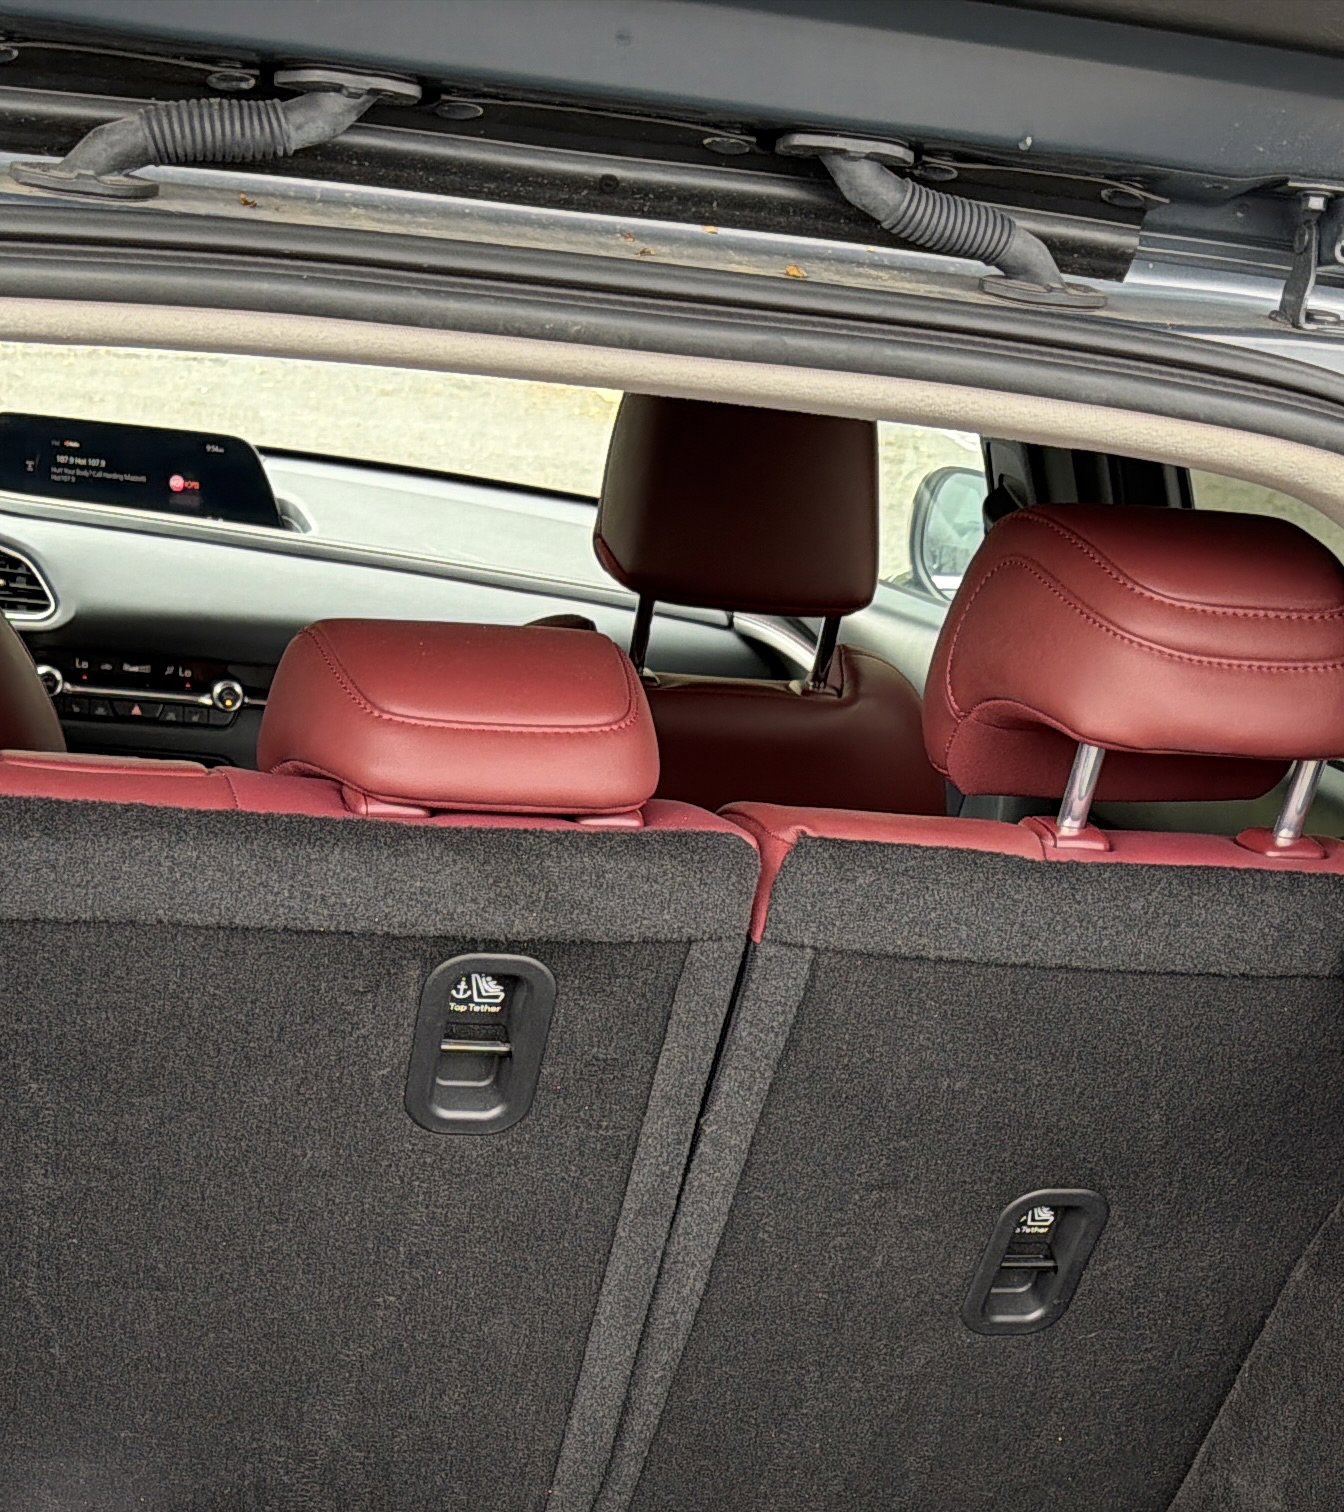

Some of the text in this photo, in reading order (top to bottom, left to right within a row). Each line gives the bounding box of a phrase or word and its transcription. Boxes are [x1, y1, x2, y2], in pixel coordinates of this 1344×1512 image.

[76, 657, 89, 669] Lo
[179, 666, 192, 677] Lo
[449, 1002, 501, 1013] Top Tether
[1021, 1226, 1049, 1234] Tether
